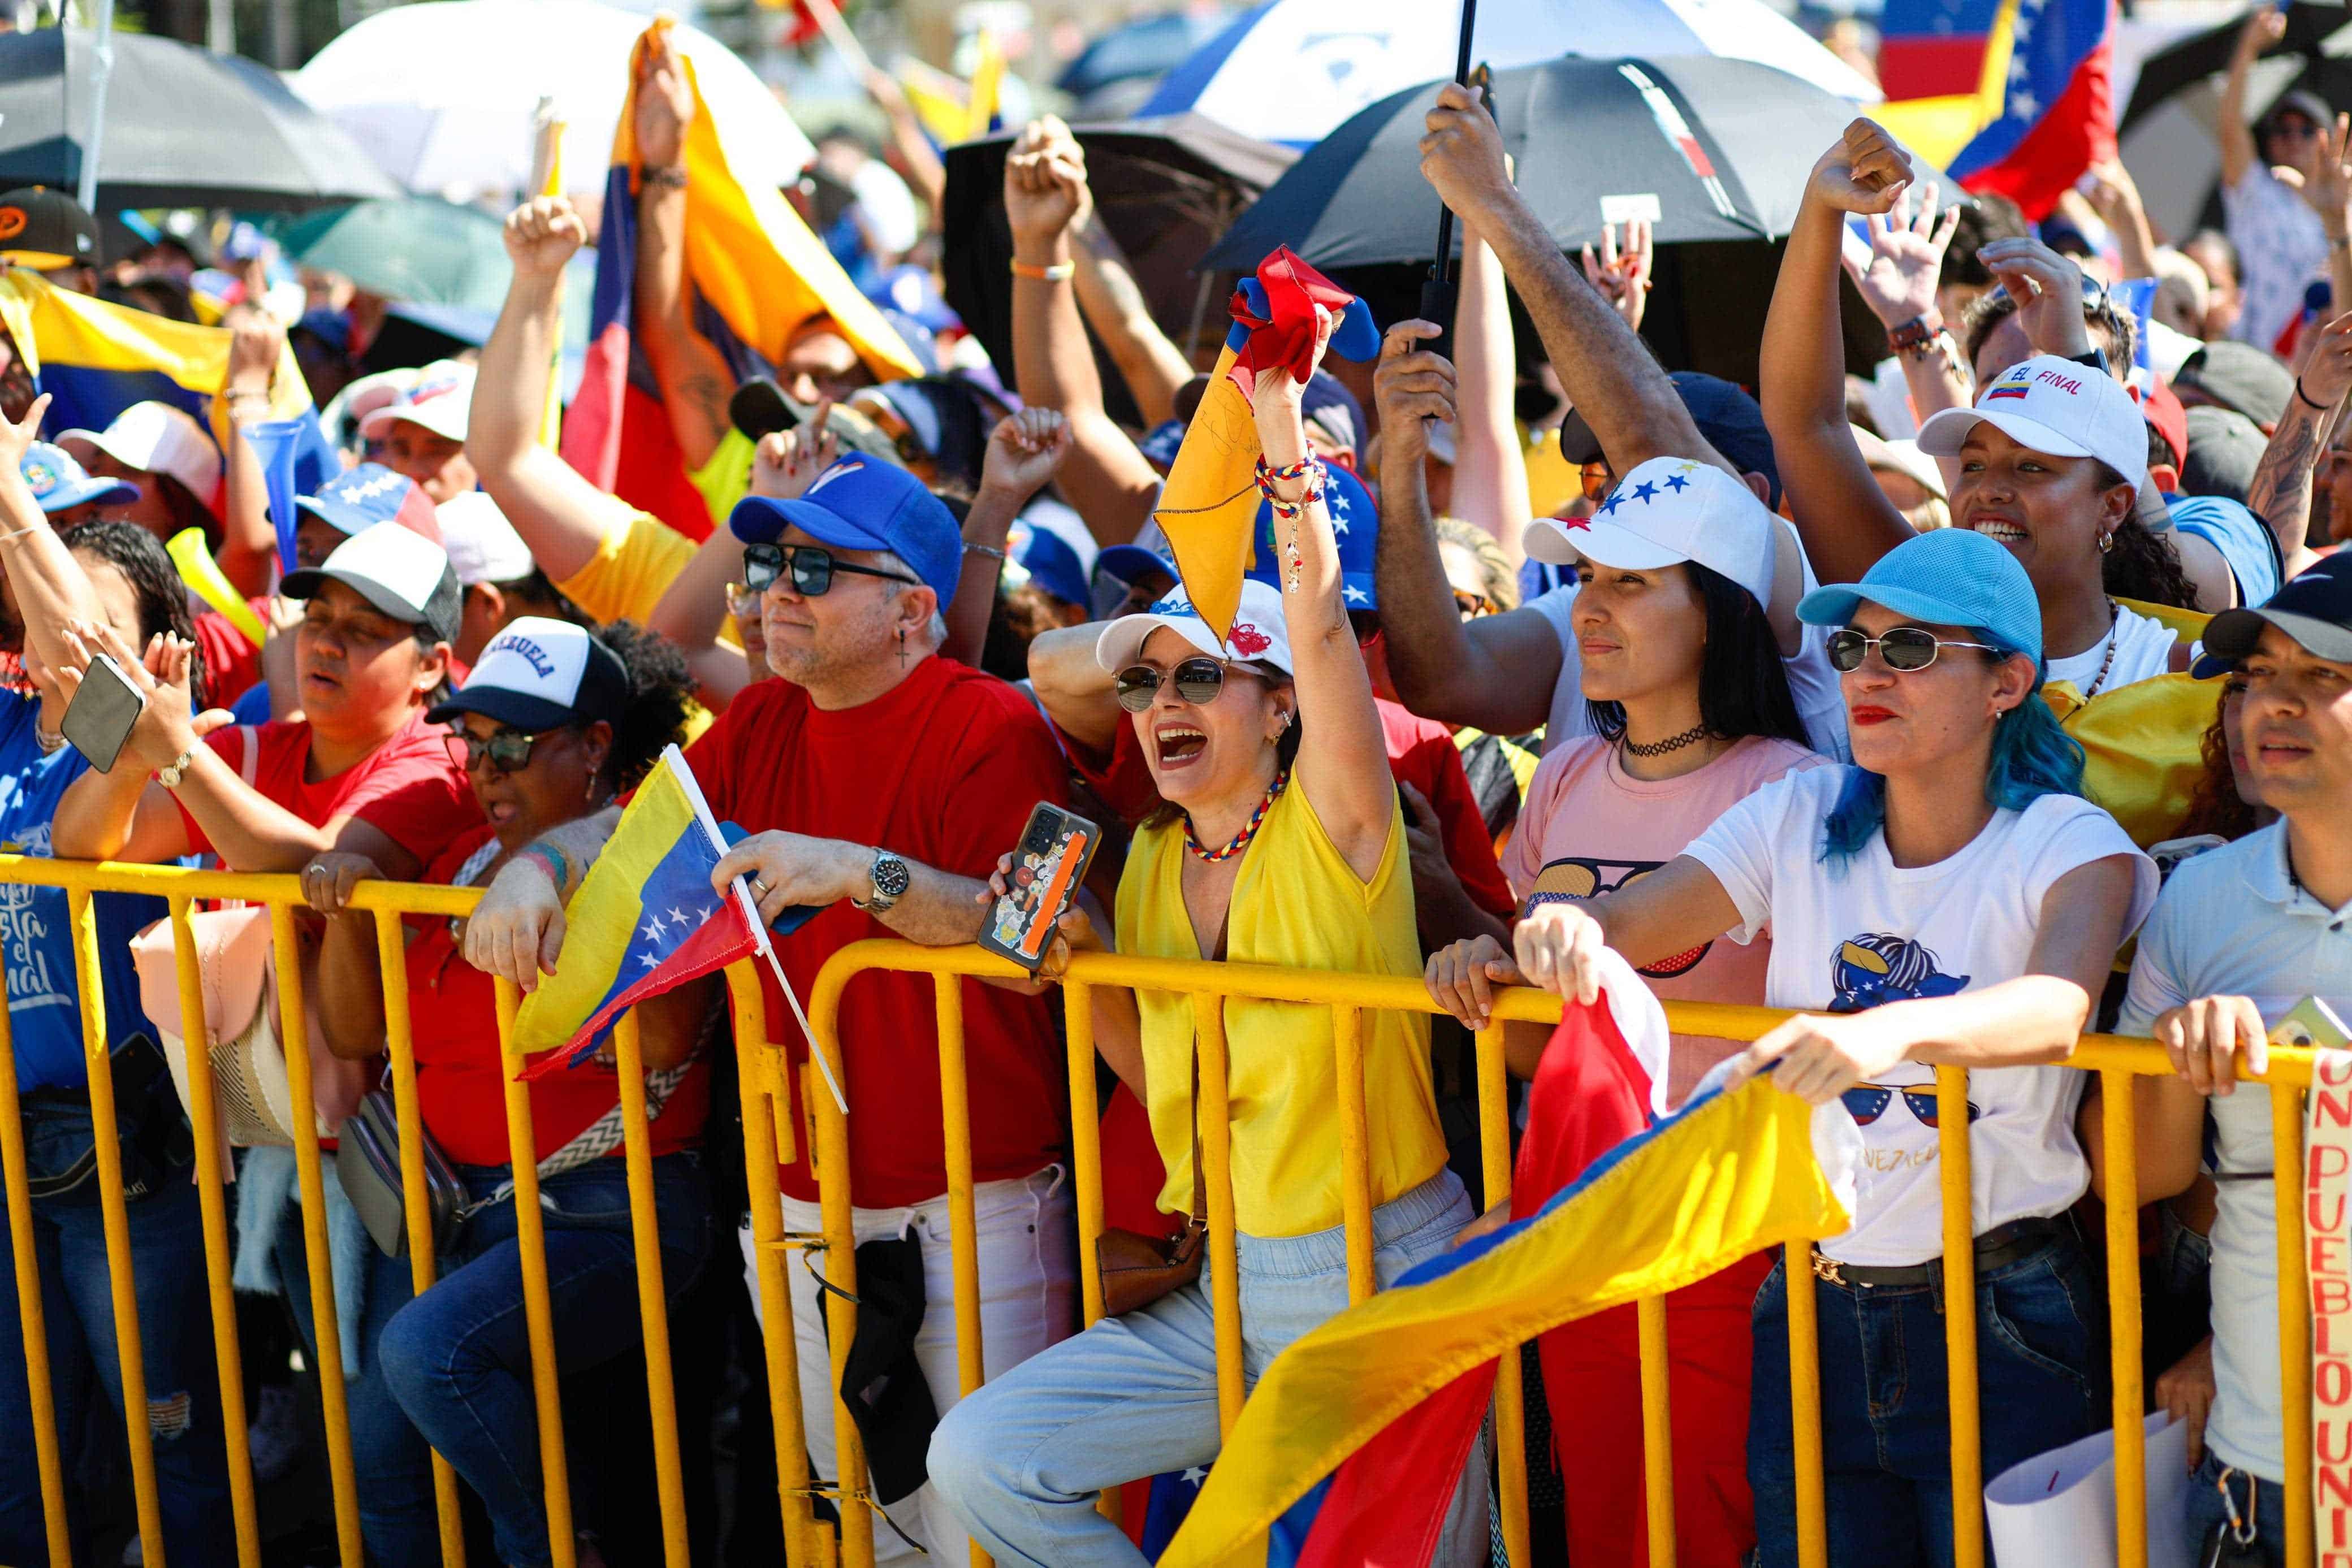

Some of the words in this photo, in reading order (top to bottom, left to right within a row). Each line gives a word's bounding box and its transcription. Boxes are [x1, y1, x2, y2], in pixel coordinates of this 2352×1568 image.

[2011, 366, 2031, 382] EL
[2035, 370, 2082, 396] FINAL
[0, 904, 47, 942] sta
[6, 949, 55, 997] nal
[2315, 1055, 2352, 1129] UN
[2307, 1145, 2352, 1407] PUEBLO
